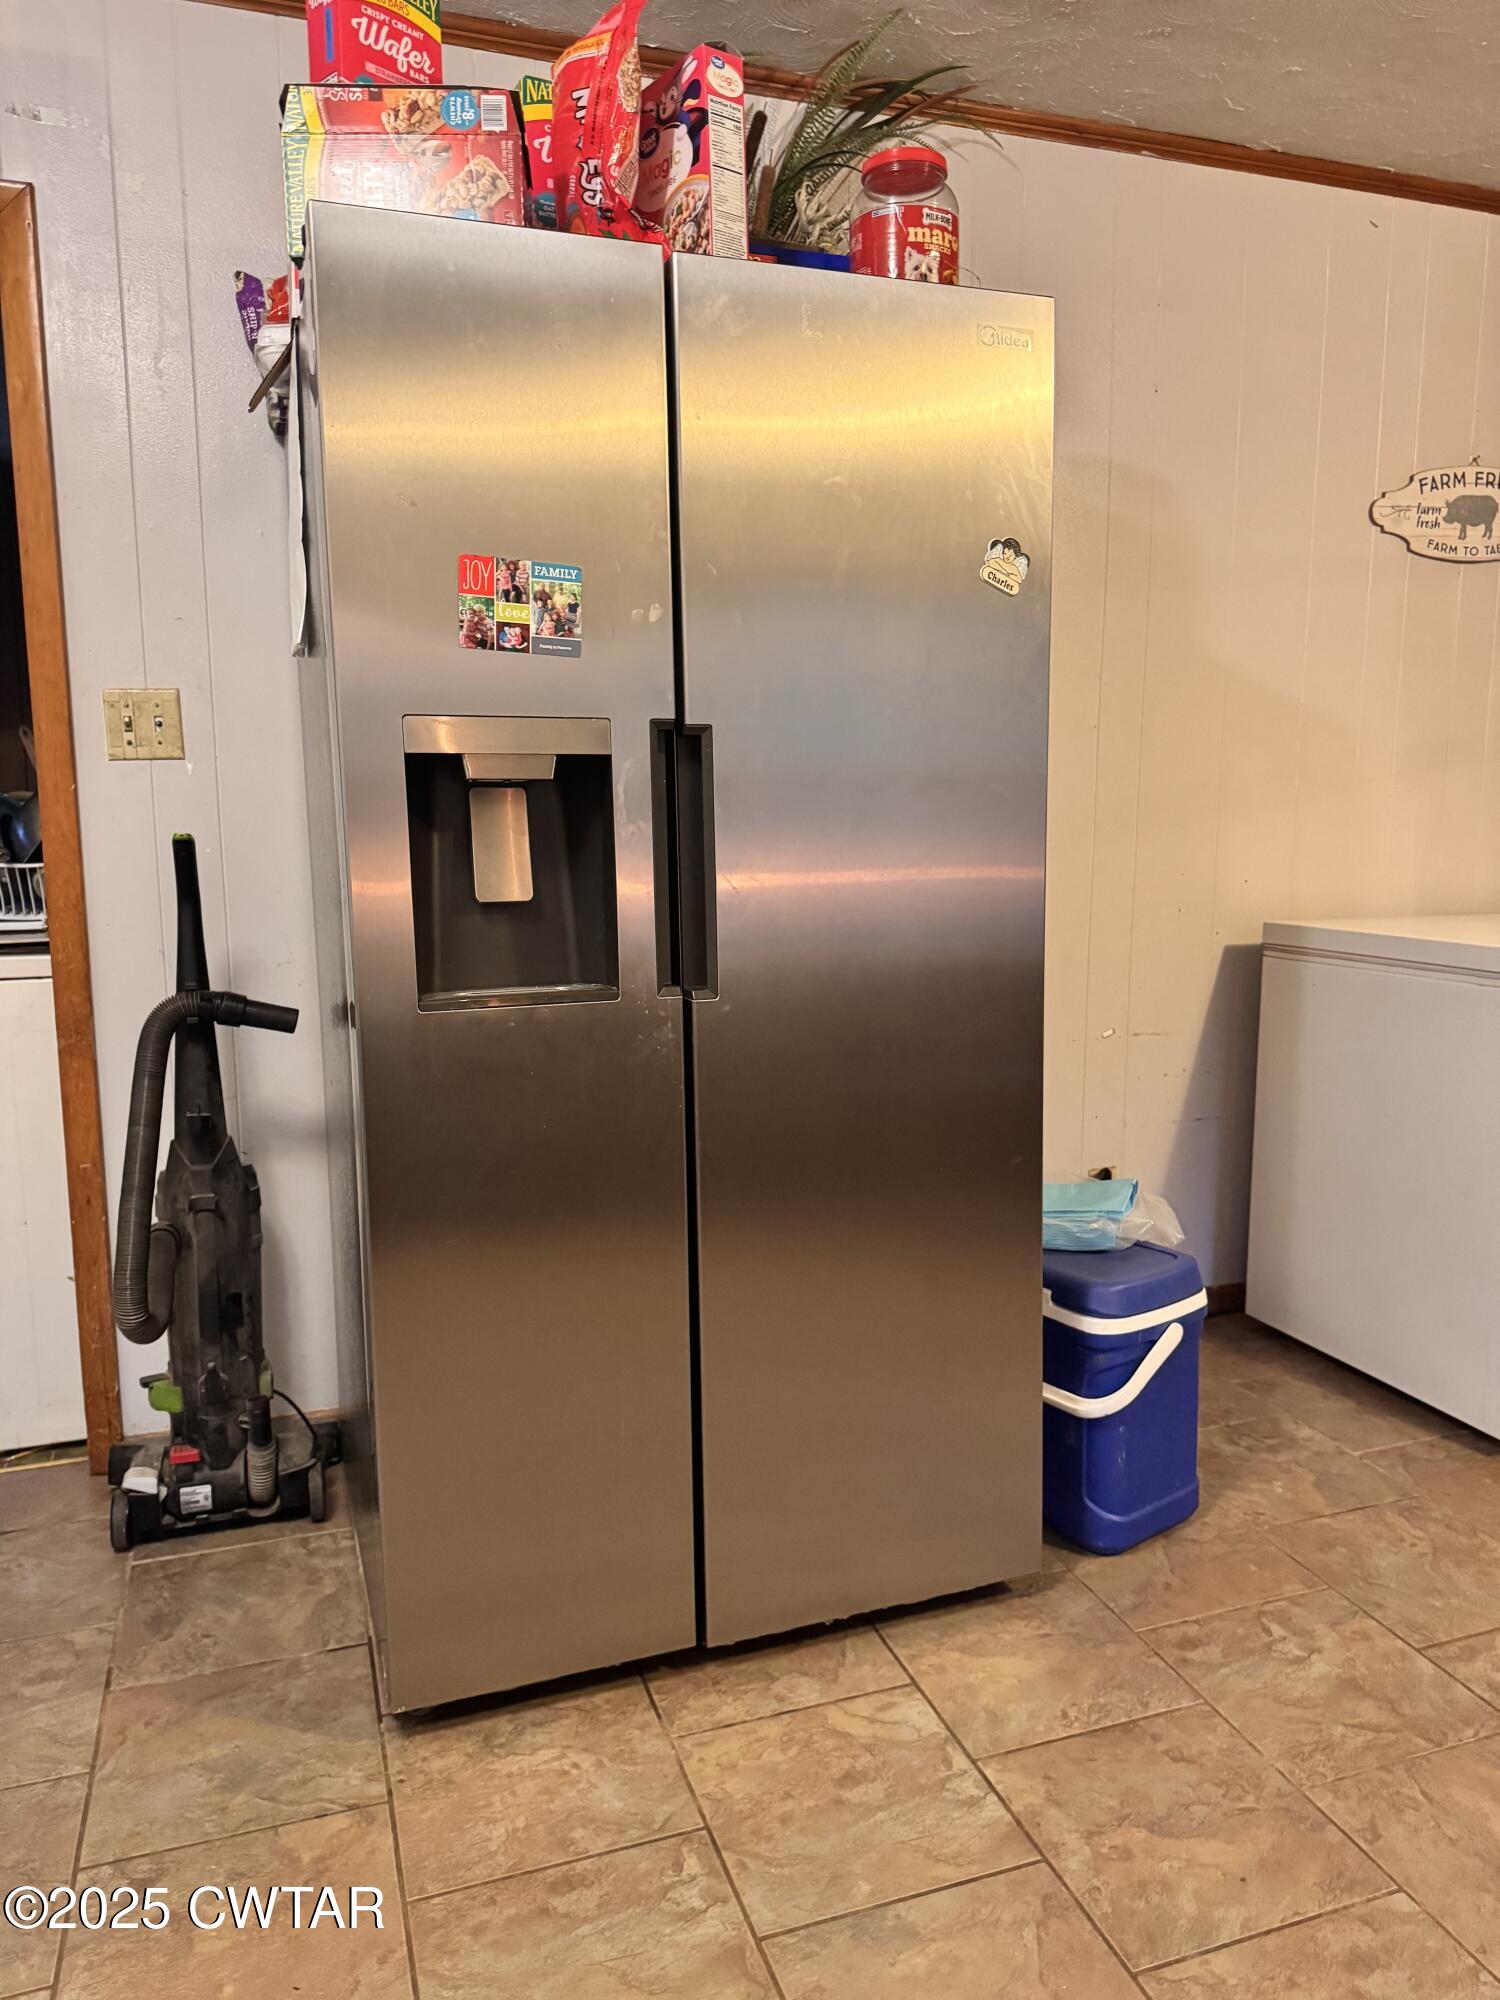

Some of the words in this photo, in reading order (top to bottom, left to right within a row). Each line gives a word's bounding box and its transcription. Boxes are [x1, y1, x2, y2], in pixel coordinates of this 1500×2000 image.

[361, 5, 391, 23] CRISPY
[391, 19, 425, 41] CREAMY
[351, 16, 435, 74] Wafer
[409, 69, 430, 84] BARS
[287, 140, 308, 193] VALLEY
[568, 174, 577, 199] CEREAL
[925, 211, 951, 227] MILK-BONE
[924, 243, 951, 255] SNACKS
[980, 325, 1028, 349] Midea
[1418, 471, 1466, 495] FARM
[1416, 502, 1442, 516] farm
[1416, 515, 1441, 530] fresh
[1427, 538, 1458, 556] FARM
[1463, 546, 1479, 557] TO
[462, 559, 492, 591] JOY
[534, 565, 578, 580] FAMILY
[987, 571, 1014, 592] Charles
[498, 598, 529, 618] love
